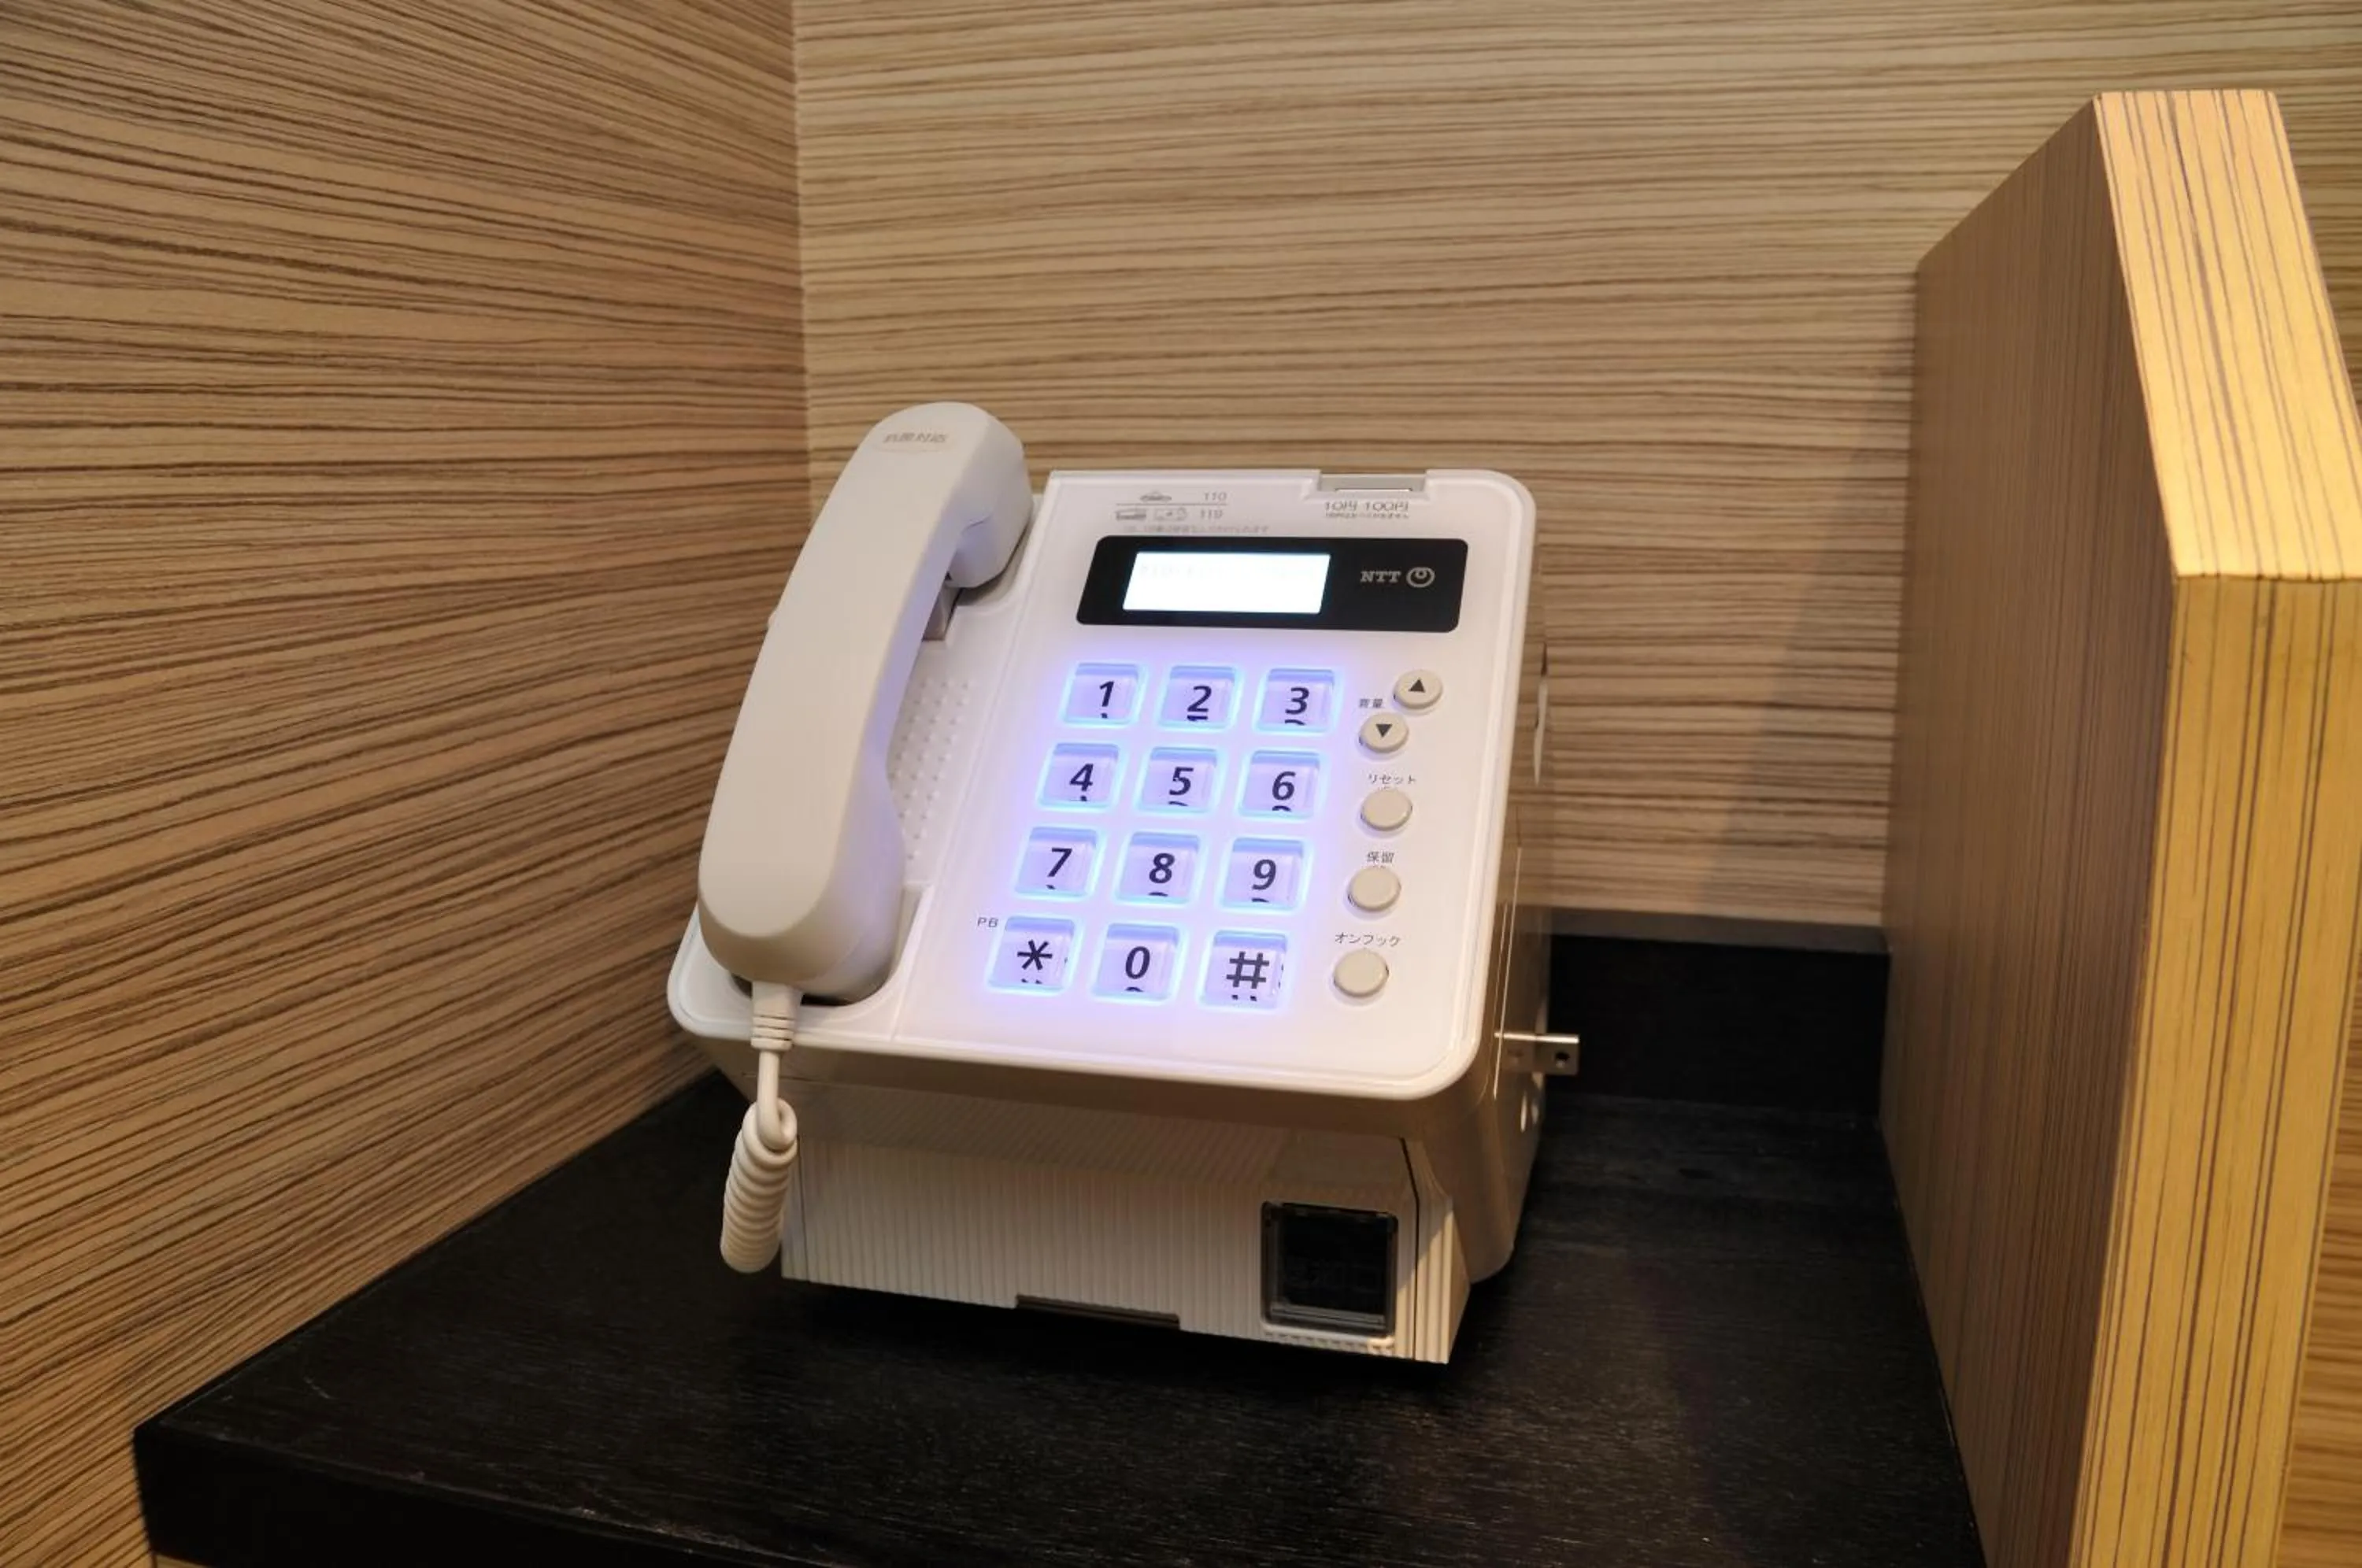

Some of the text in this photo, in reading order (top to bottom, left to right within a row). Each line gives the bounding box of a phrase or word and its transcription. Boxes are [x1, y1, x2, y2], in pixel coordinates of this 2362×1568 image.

[1204, 491, 1227, 501] 110
[1360, 570, 1401, 583] NTT
[1099, 681, 1310, 716] 1 2 3
[1069, 763, 1296, 801] 4 5 6
[1368, 773, 1416, 785] リセット
[1366, 851, 1395, 864] 保留
[1047, 847, 1276, 890] 7 8 9
[977, 916, 999, 928] PB
[1335, 931, 1401, 947] オンフック
[1125, 946, 1150, 980] 0
